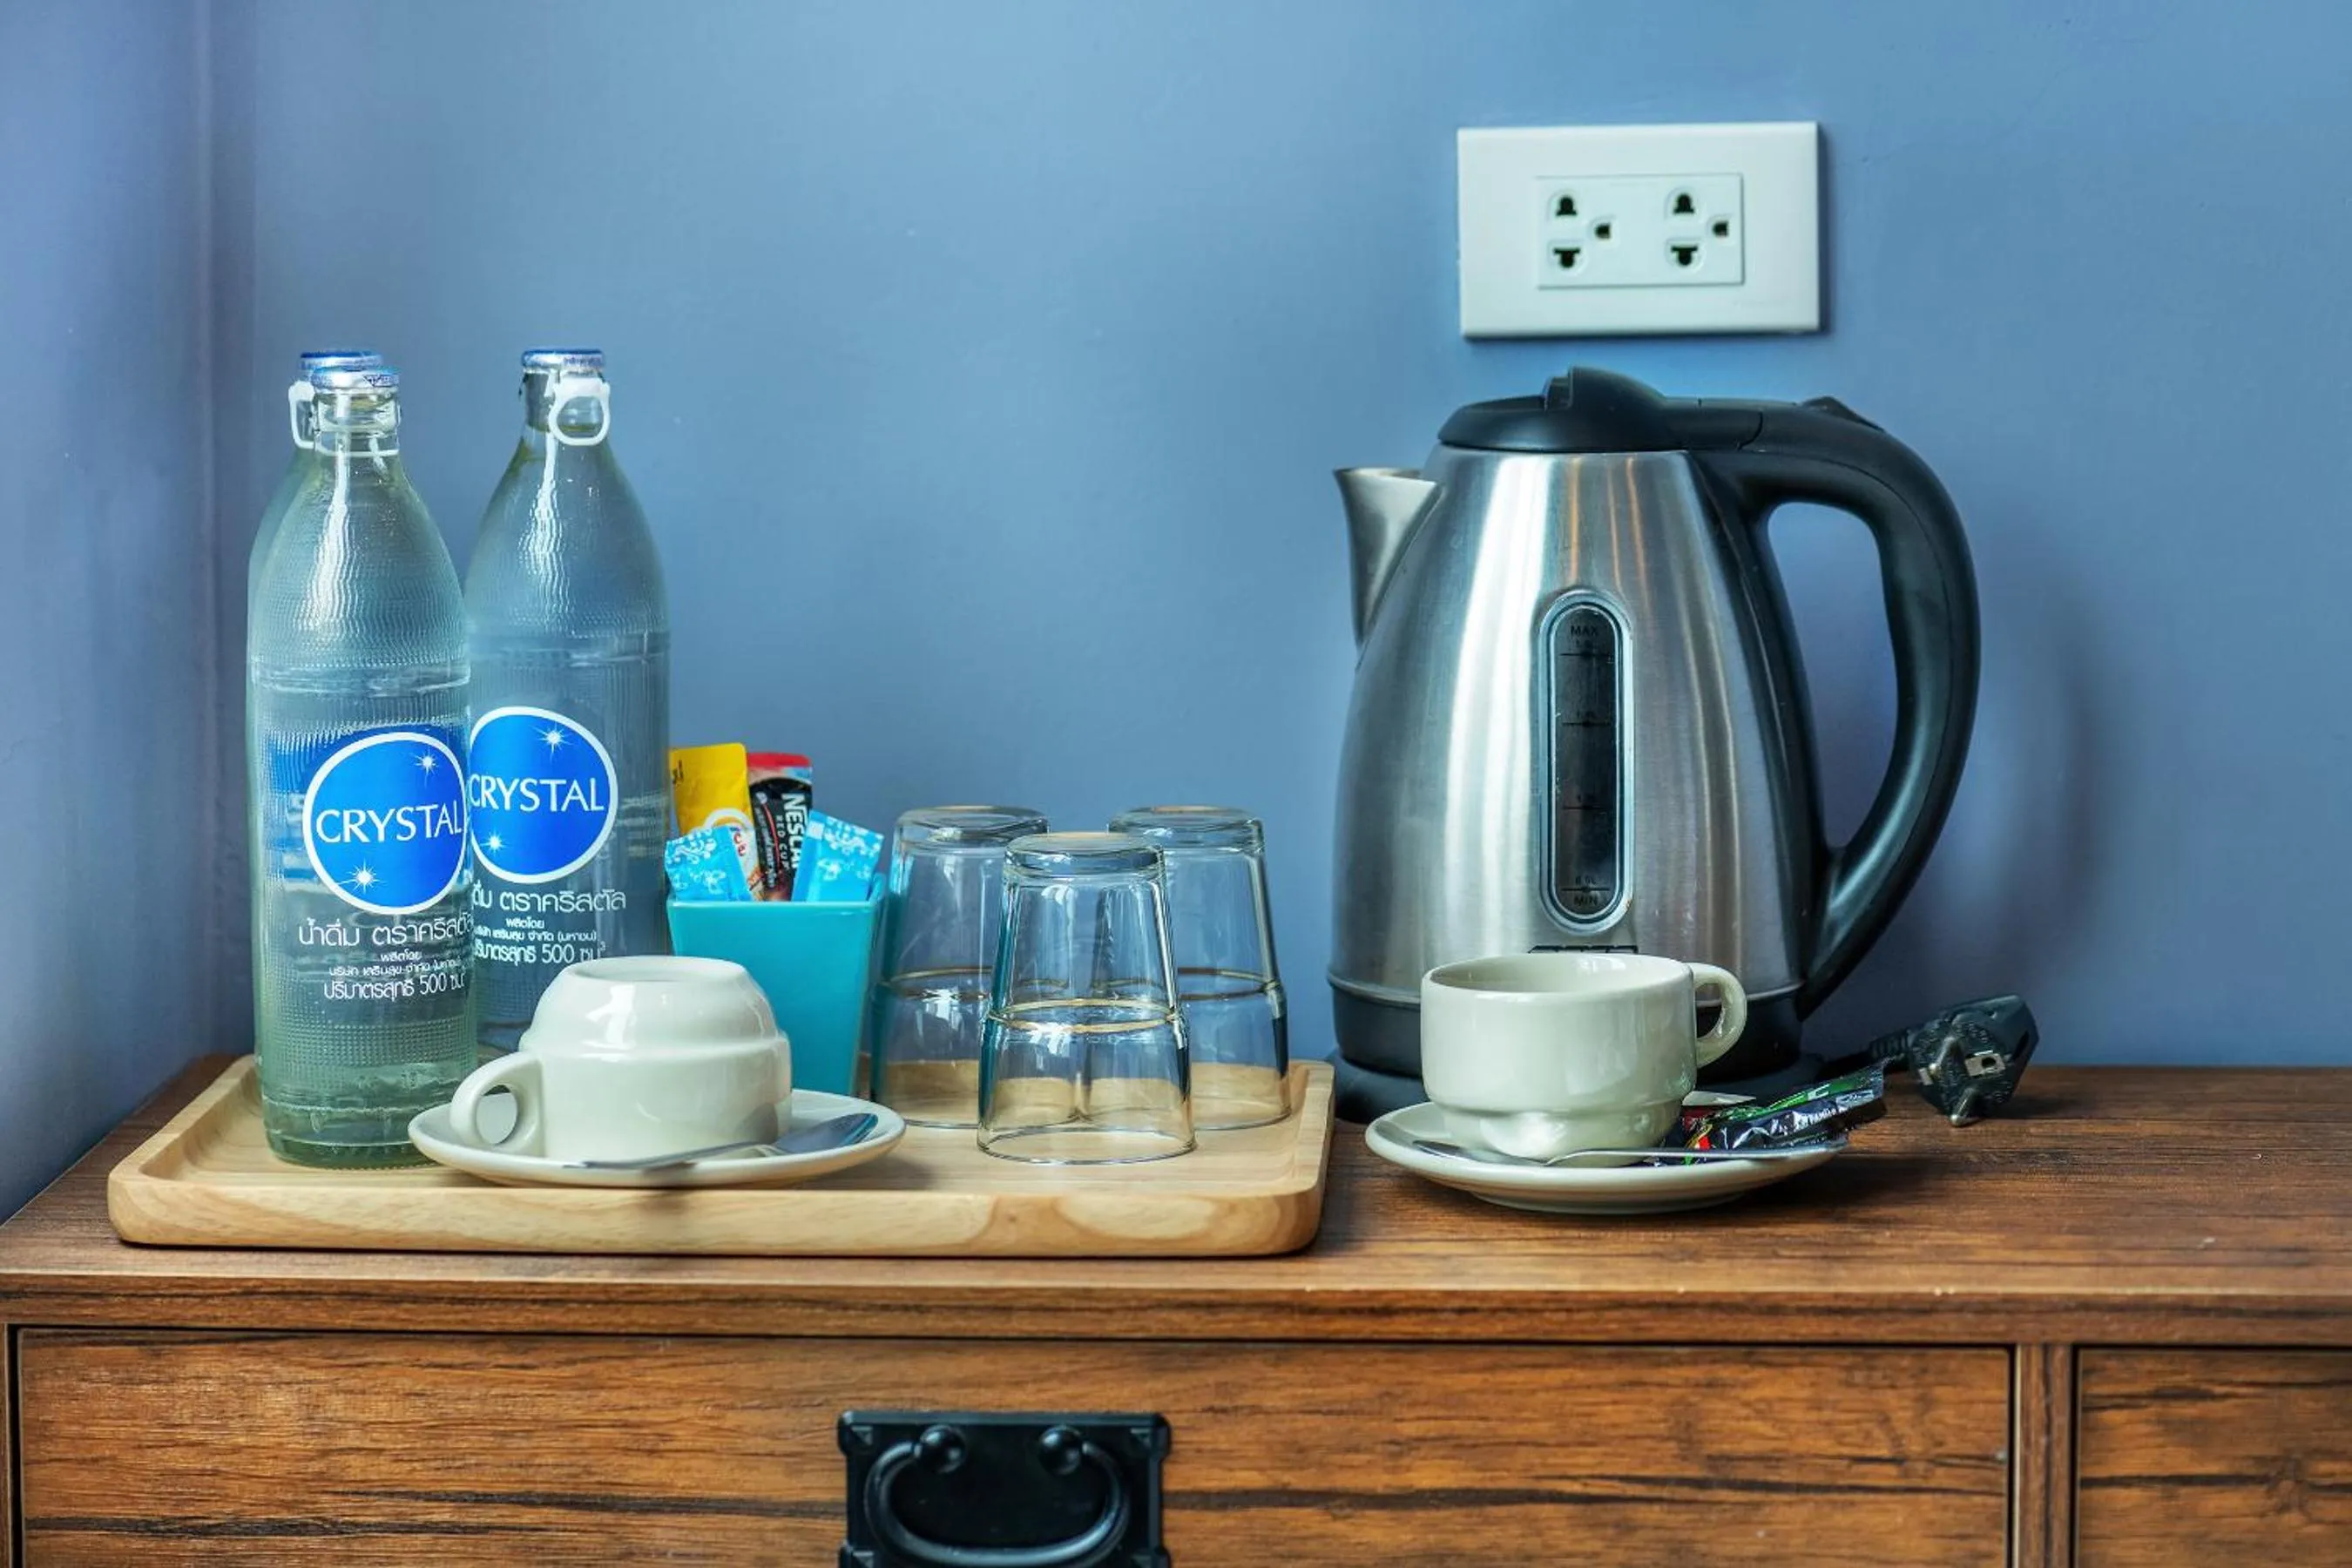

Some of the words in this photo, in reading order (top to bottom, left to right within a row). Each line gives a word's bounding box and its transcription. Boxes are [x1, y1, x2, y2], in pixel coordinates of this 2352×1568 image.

[470, 774, 605, 813] CRYSTAL
[315, 799, 463, 843] CRYSTAL
[776, 814, 787, 839] RED
[499, 889, 626, 913] ตราคริสตัล
[298, 916, 361, 947] น้ำดื่ม
[542, 943, 575, 963] 500
[323, 978, 416, 1002] ปริมาตรสุทธิ
[419, 971, 448, 996] 500
